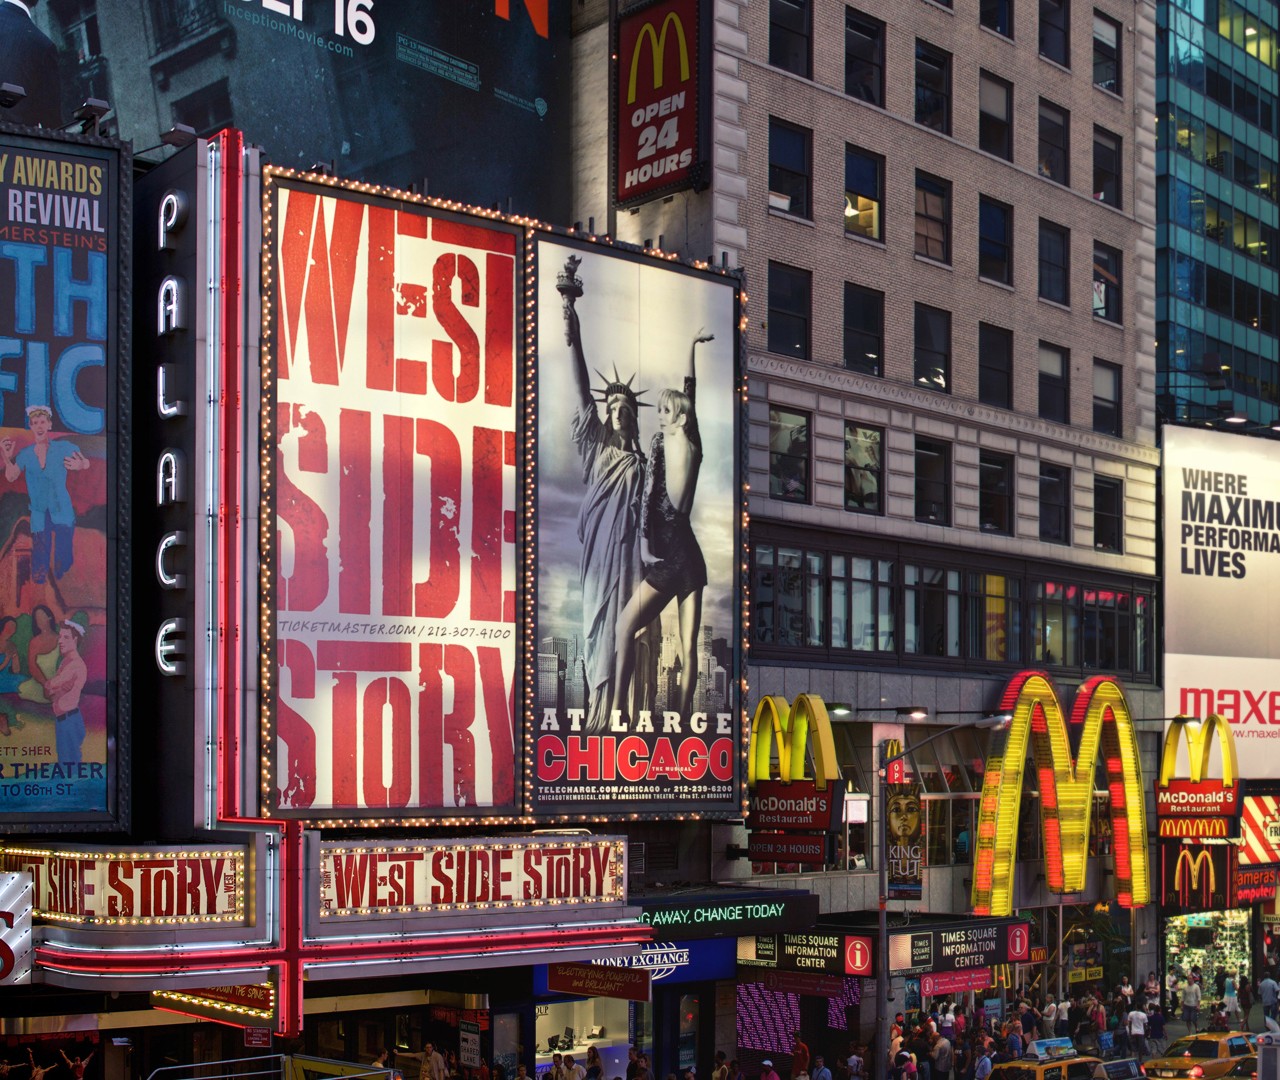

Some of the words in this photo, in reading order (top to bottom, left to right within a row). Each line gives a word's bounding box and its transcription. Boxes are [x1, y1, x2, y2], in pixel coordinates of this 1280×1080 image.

[223, 3, 353, 57] InceptionMovie.com
[632, 91, 685, 127] OPEN
[637, 117, 679, 160] 24
[13, 156, 102, 195] AWARDS
[625, 148, 692, 188] HOURS
[8, 189, 104, 232] REVIVAL
[278, 190, 516, 406] WEST
[155, 189, 188, 676] PALACE
[1182, 468, 1248, 496] WHERE
[277, 402, 516, 623] SIDE
[1182, 547, 1246, 580] LIVES
[279, 620, 416, 635] TICKETMASTER.COM
[277, 638, 516, 810] STORY
[540, 708, 585, 731] AT
[611, 710, 732, 734] LARGE
[22, 746, 51, 756] SHER
[537, 734, 734, 782] CHICAGO
[10, 762, 103, 779] THEATER
[3, 785, 20, 796] TO
[538, 786, 660, 794] TELECHARGE.COM/CHICAGO
[674, 785, 732, 793] 212-239-6200
[1158, 790, 1233, 803] McDonald's
[749, 796, 827, 812] McDonald's
[759, 814, 813, 823] Restaurant
[750, 843, 773, 853] OPEN
[777, 844, 787, 853] 24
[790, 844, 821, 855] HOURS
[889, 846, 921, 859] KING
[889, 859, 921, 876] TUT
[333, 852, 424, 909] WEST
[431, 850, 513, 905] SIDE
[523, 847, 611, 900] STORY
[48, 858, 96, 916] SIDE
[108, 858, 225, 917] STORY
[652, 909, 692, 926] AWAY,
[694, 906, 743, 923] CHANGE
[745, 903, 785, 919] TODAY
[784, 933, 806, 945] TIMES
[808, 935, 839, 947] SQUARE
[914, 939, 928, 947] TIMES
[941, 931, 966, 944] TIMES
[967, 928, 997, 941] SQUARE
[785, 945, 837, 958] INFORMATION
[913, 947, 930, 955] SQUARE
[942, 940, 996, 957] INFORMATION
[591, 955, 630, 968] MONEY
[632, 951, 689, 967] EXCHANGE
[796, 957, 825, 968] CENTER
[954, 954, 984, 967] CENTER
